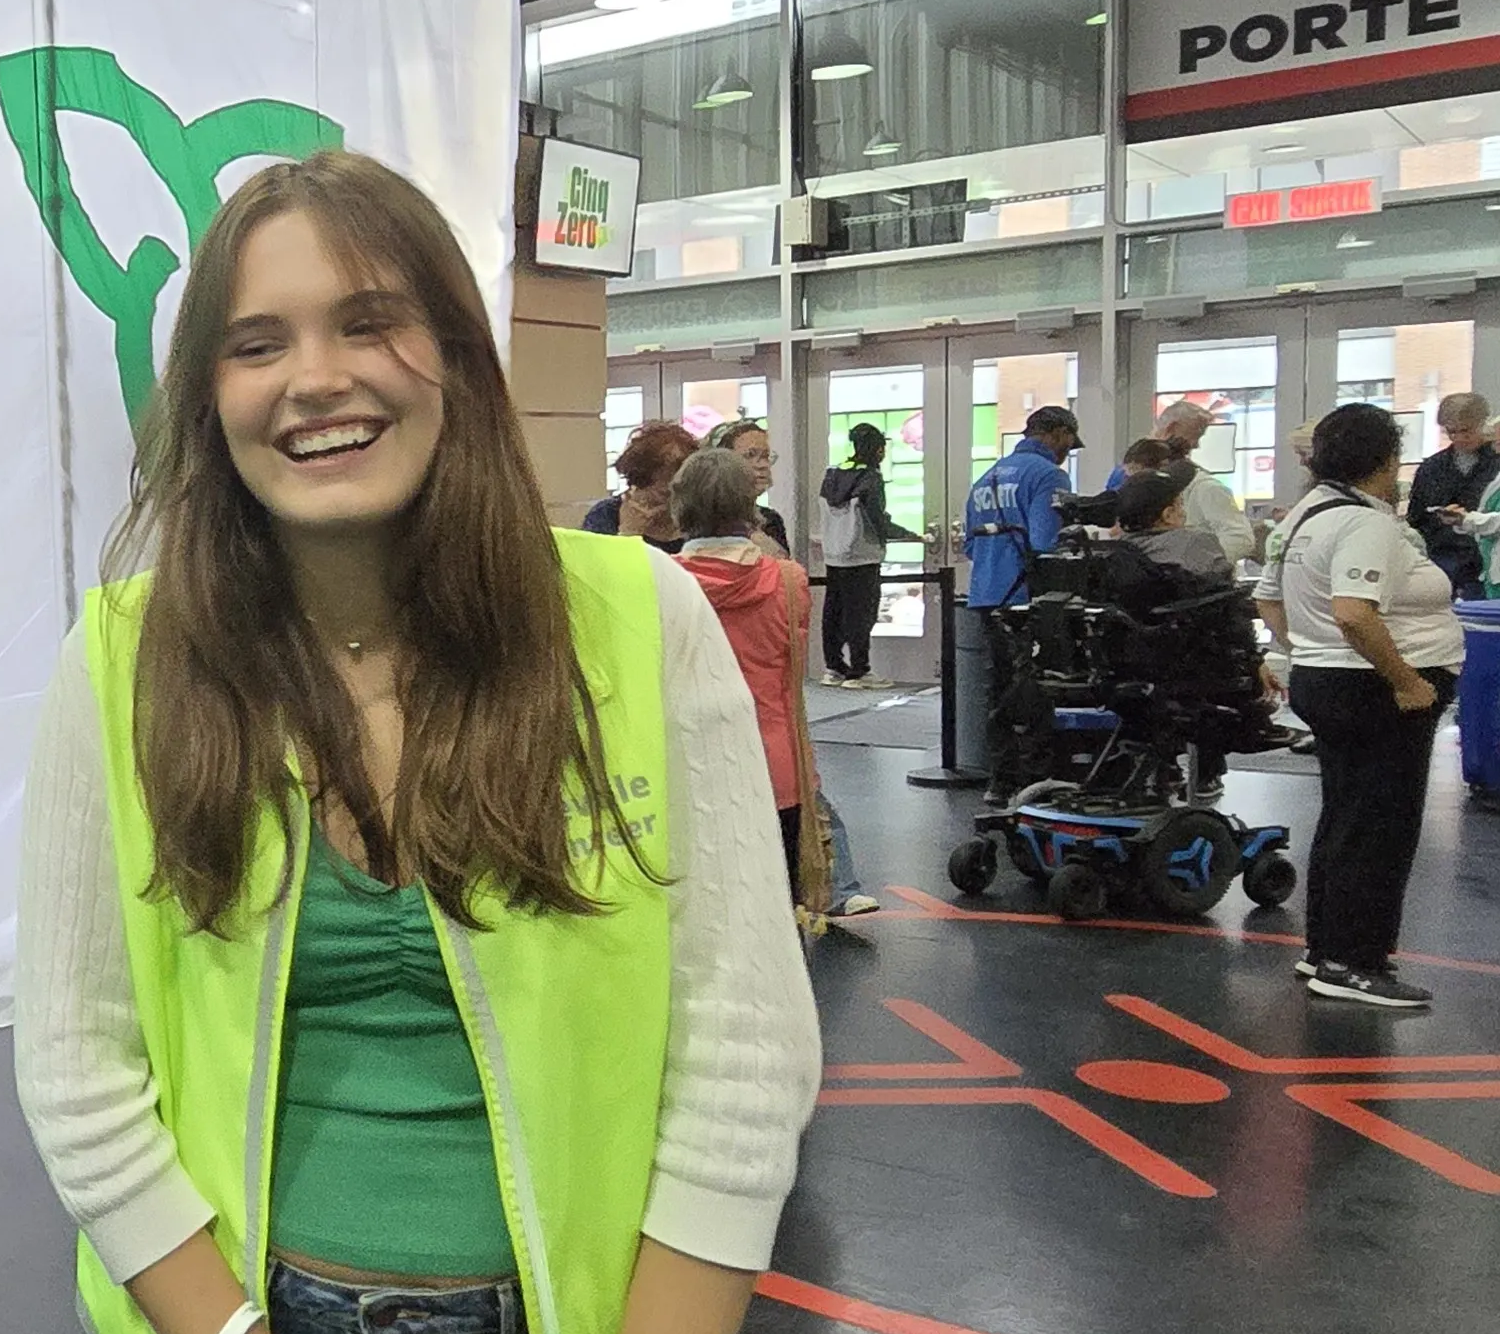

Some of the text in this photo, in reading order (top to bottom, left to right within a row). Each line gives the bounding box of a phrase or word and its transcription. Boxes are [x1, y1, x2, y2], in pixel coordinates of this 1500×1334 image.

[569, 166, 609, 223] Cinq
[1232, 191, 1281, 225] EXIT
[554, 200, 598, 249] Zero
